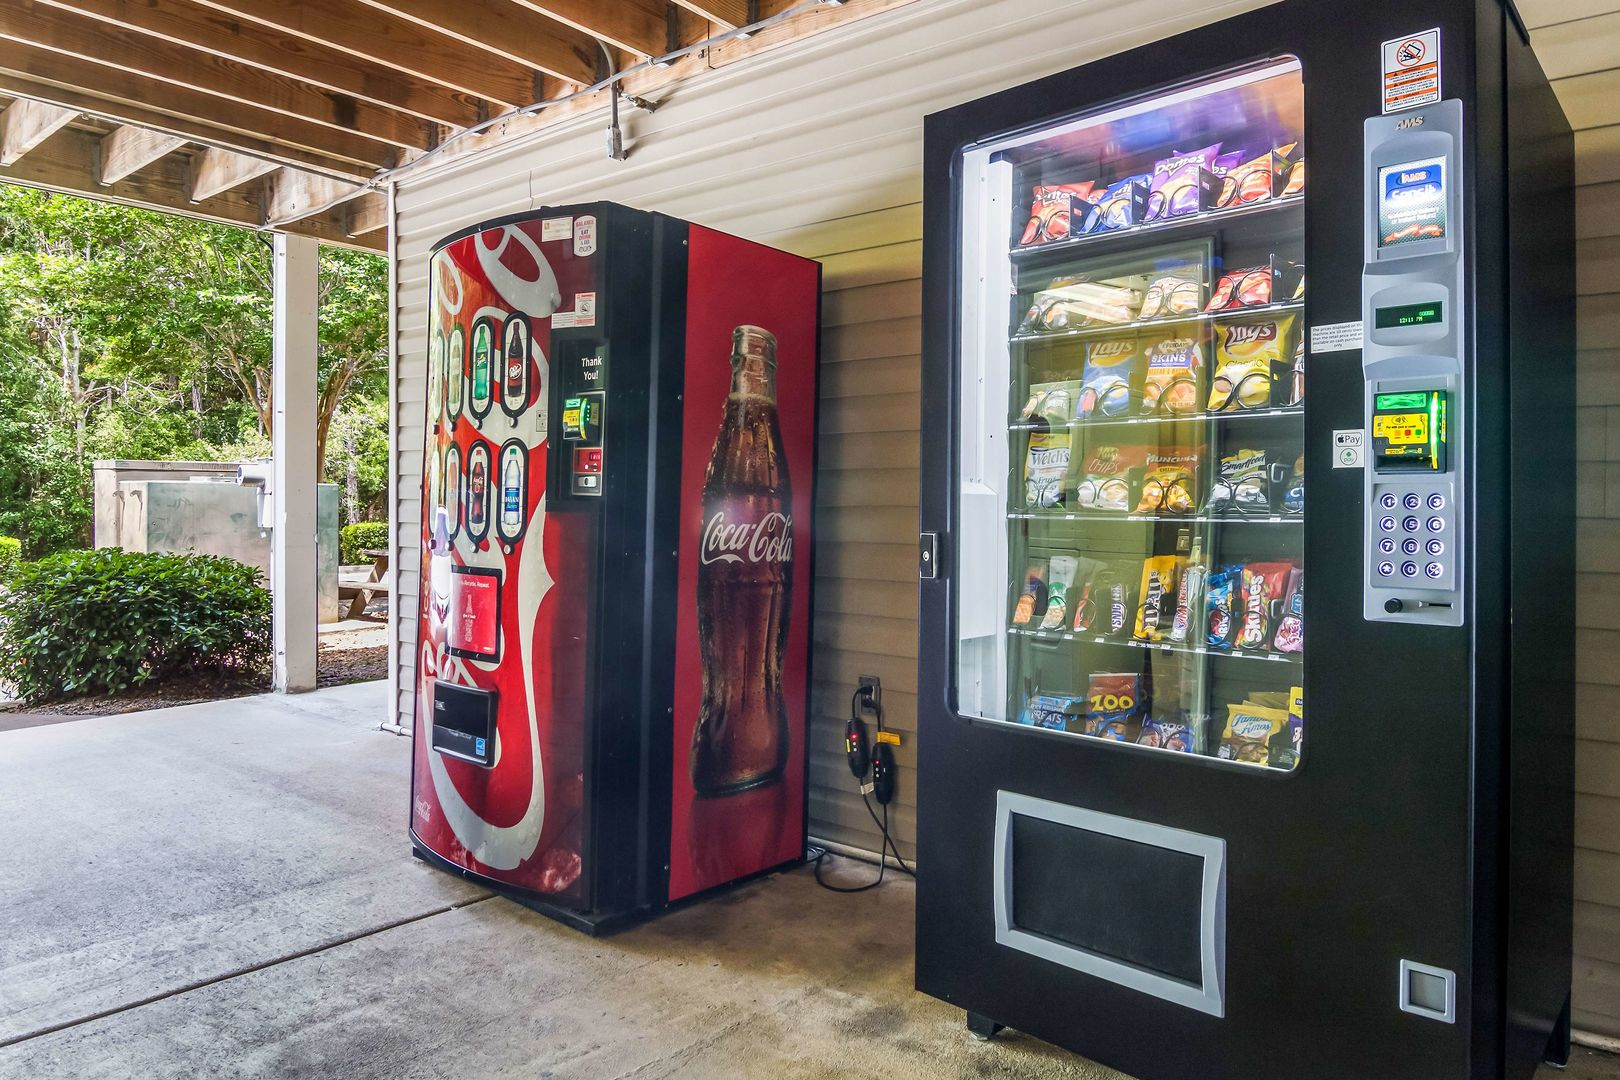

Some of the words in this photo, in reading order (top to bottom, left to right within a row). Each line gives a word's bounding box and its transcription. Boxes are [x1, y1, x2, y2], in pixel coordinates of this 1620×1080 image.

[1395, 116, 1424, 130] AMS
[581, 355, 603, 368] Thank
[1151, 353, 1187, 363] SKINS
[583, 370, 599, 381] You!
[1345, 435, 1360, 444] Pay
[1031, 450, 1069, 466] Welch's
[1088, 458, 1119, 475] CHIPS
[701, 511, 793, 565] Coca-Cola
[1090, 693, 1135, 712] ZOO
[1031, 709, 1062, 724] TREATS
